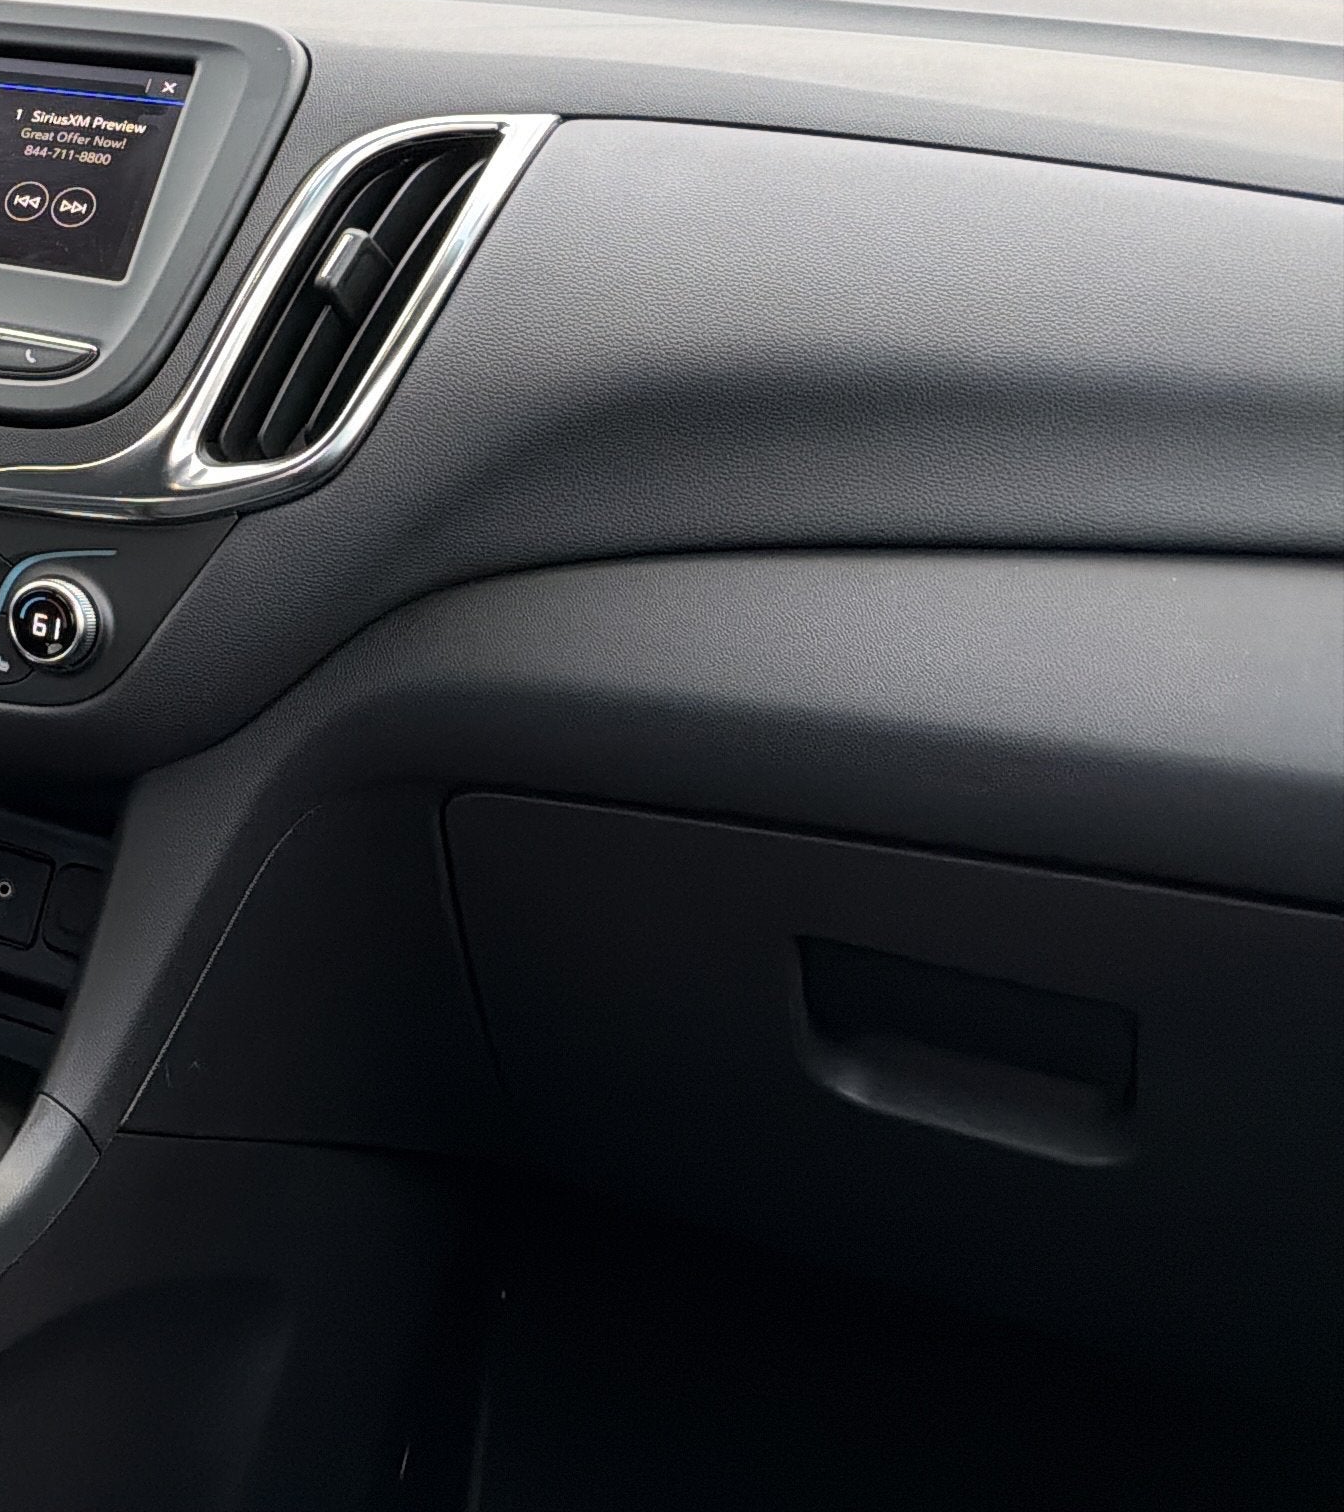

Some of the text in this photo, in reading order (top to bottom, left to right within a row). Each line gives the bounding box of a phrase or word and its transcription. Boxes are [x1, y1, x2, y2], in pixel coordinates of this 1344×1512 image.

[15, 108, 147, 135] 1 SiriusXM Preview
[21, 127, 127, 150] Great Offer Now!
[24, 143, 113, 166] 844-711-8800
[32, 612, 60, 637] 61
